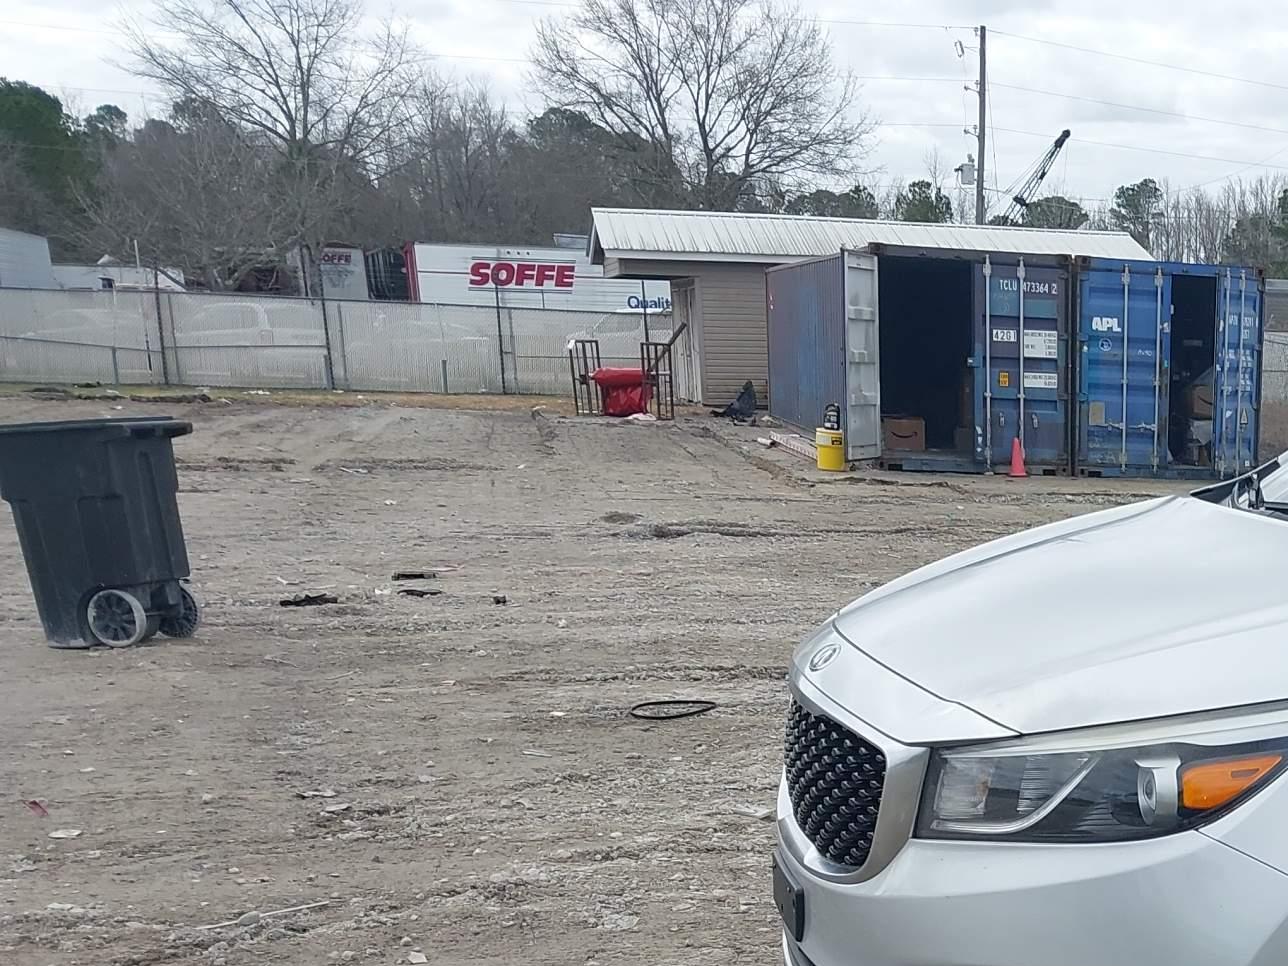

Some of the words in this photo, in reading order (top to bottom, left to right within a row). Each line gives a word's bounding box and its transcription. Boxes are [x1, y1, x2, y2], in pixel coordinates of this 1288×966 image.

[469, 262, 575, 288] SOFFE
[999, 279, 1018, 291] TCLU
[627, 295, 672, 309] Qualit
[1092, 316, 1122, 332] APL
